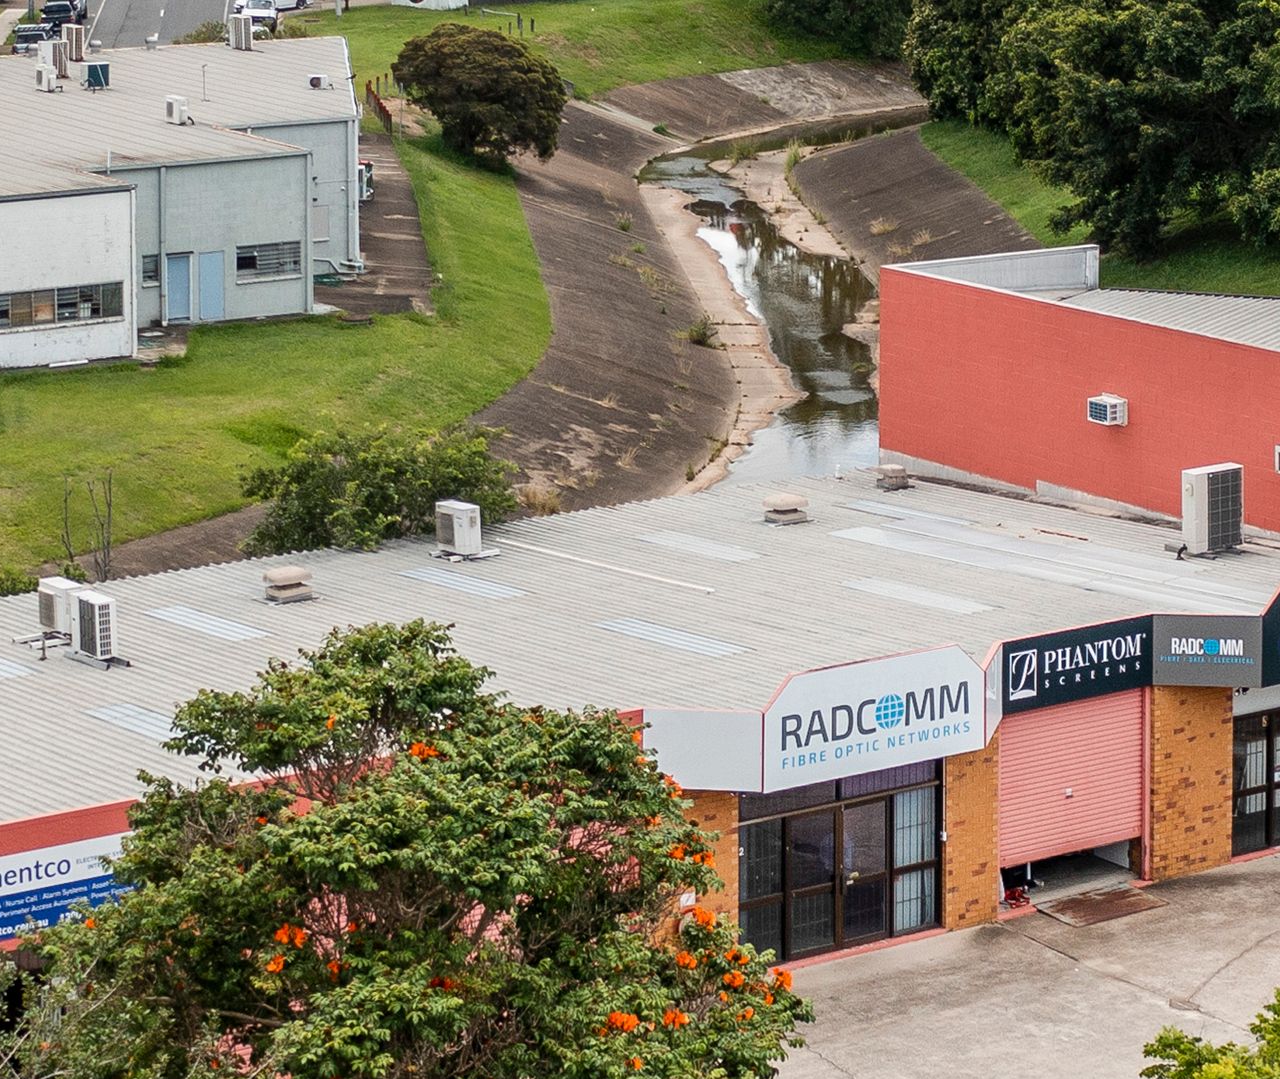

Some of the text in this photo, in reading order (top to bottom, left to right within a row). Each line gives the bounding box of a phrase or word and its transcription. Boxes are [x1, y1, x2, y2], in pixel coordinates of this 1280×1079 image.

[1044, 634, 1142, 674] PHANTOM
[1044, 660, 1141, 689] SCREENS
[782, 721, 970, 769] FIBRE OPTIC NETWORKS
[738, 846, 744, 856] 2
[5, 898, 25, 907] Nurse
[25, 895, 38, 903] Call
[42, 891, 61, 900] Alarm
[62, 886, 88, 896] Systems
[0, 907, 31, 918] Perimeter
[31, 902, 52, 912] Access
